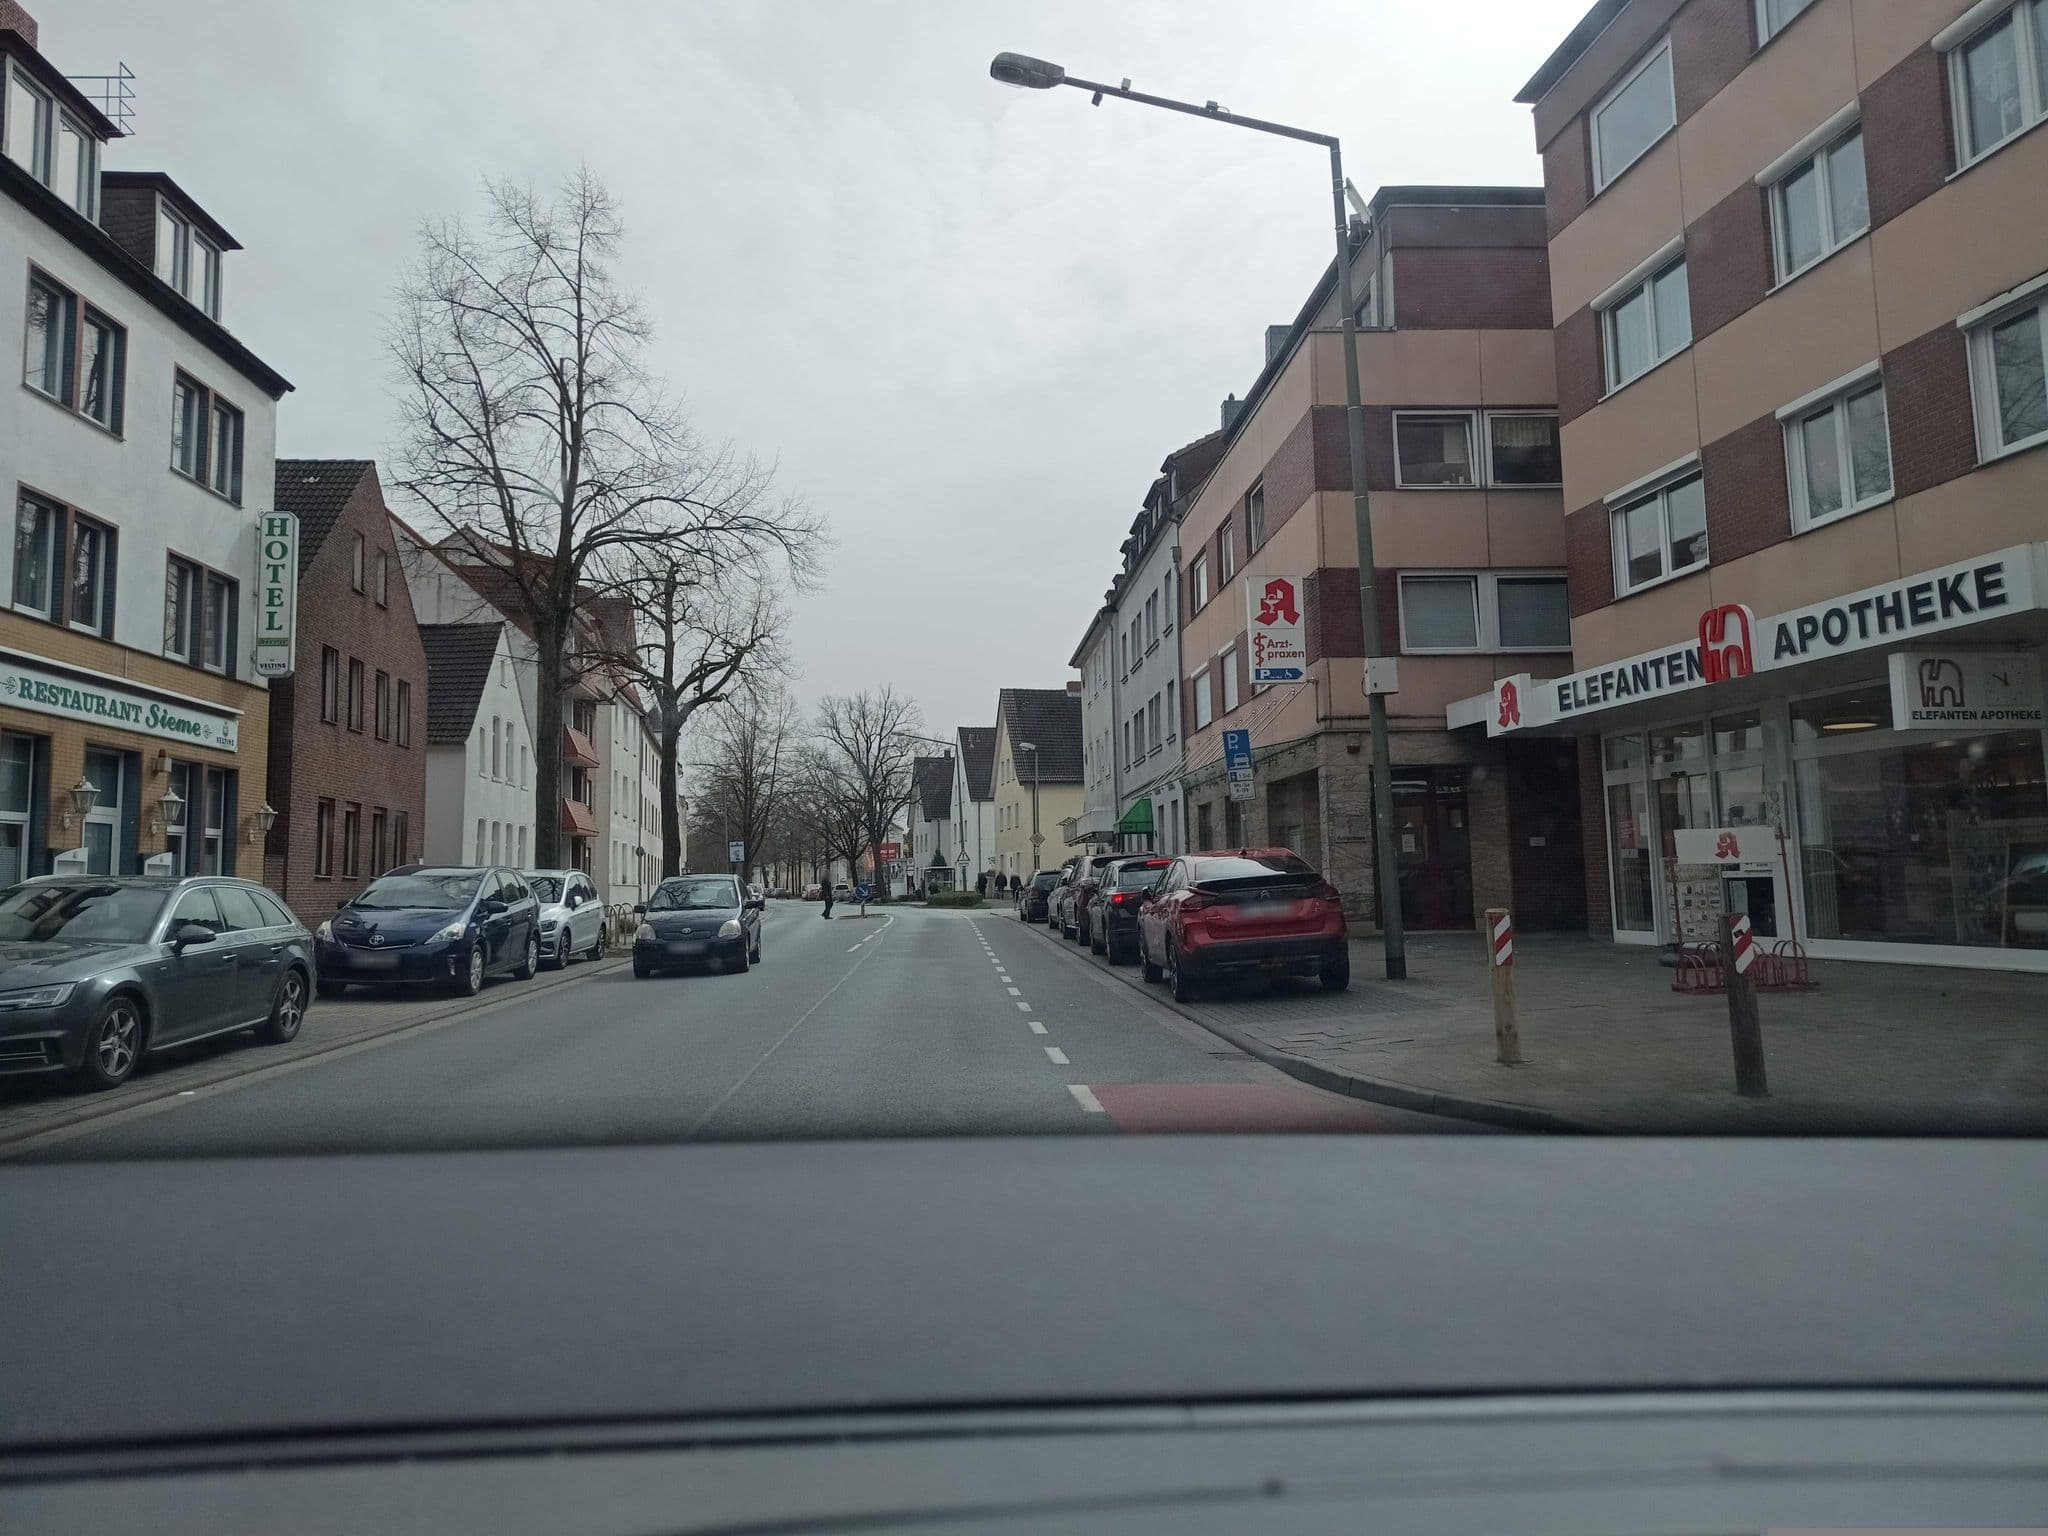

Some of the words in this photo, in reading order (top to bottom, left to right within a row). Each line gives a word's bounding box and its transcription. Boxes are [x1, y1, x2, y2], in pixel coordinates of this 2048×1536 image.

[264, 516, 289, 632] HOTEL
[1774, 561, 2009, 660] APOTHEKE
[1266, 639, 1293, 649] Arzt-
[1267, 650, 1305, 661] praxen
[18, 677, 143, 724] RESTAURANT
[145, 704, 202, 737] Sieme
[1556, 645, 1704, 713] ELEFANTEN
[1911, 709, 1978, 721] ELEFANTEN
[1980, 709, 2042, 720] APOTHEKE
